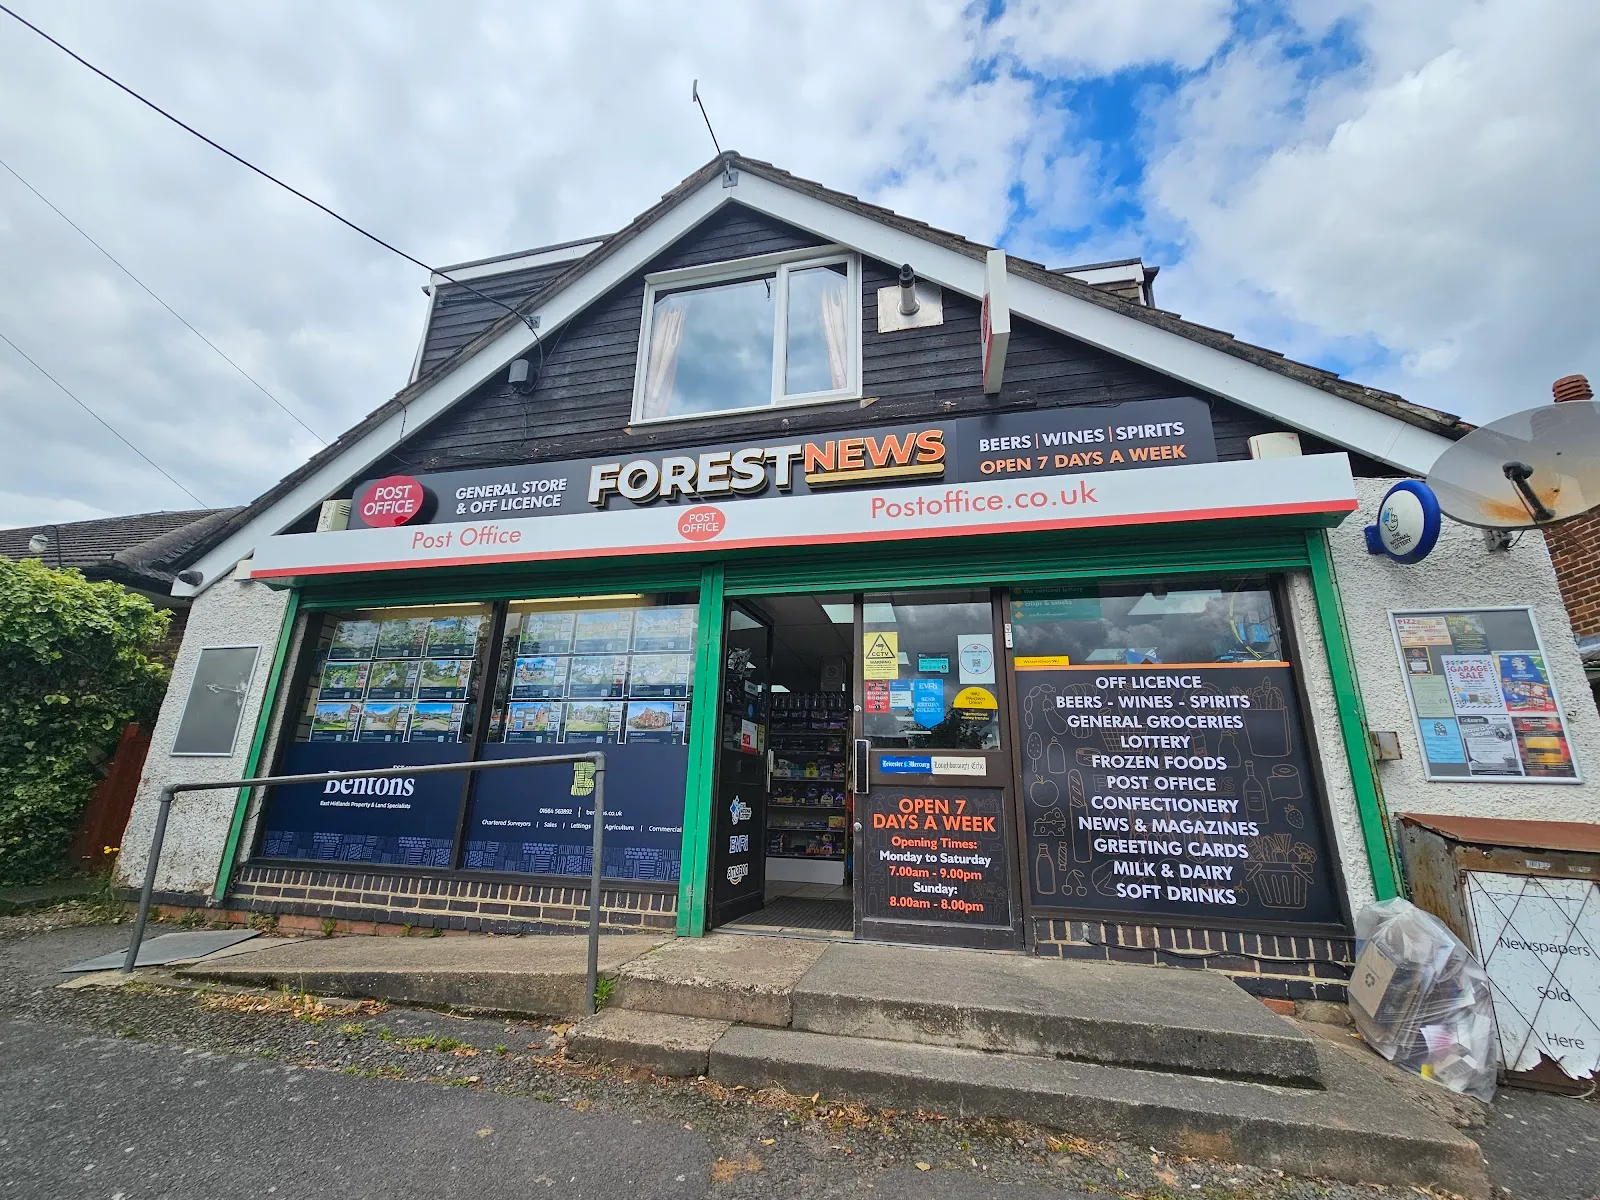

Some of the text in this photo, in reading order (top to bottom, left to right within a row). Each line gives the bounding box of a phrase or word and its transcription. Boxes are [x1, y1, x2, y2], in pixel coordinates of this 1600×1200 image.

[979, 421, 1185, 453] BEERS WINES SPIRITS
[587, 429, 946, 506] FOREST NEWS
[980, 444, 1187, 475] OPEN 7 DAYS A WEEK
[374, 485, 411, 501] POST
[455, 478, 568, 500] GENERAL STORE
[363, 499, 414, 516] OFFICE
[455, 495, 561, 515] & OFF LICENCE
[871, 480, 1099, 519] Postoffice.co.uk
[689, 512, 717, 523] POST
[681, 522, 720, 534] OFFICE
[412, 524, 521, 550] Post Office
[1450, 665, 1489, 673] GARAGE
[1095, 675, 1202, 690] OFF LICENCE
[1056, 695, 1102, 709] BEERS
[1118, 695, 1173, 709] WINES
[1190, 695, 1250, 709] SPIRITS
[1067, 715, 1243, 729] GENERAL GROCERIES
[1120, 735, 1191, 749] LOTTERY
[882, 759, 930, 769] Leicester Mercury
[971, 761, 985, 770] Echo
[1092, 755, 1228, 770] FROZEN FOODS
[322, 770, 416, 797] Bentons
[1107, 775, 1149, 790] POST
[1154, 777, 1217, 791] OFFICE
[898, 798, 967, 815] OPEN 7
[1091, 796, 1239, 814] CONFECTIONERY
[507, 820, 531, 828] Surveyors
[604, 823, 635, 831] Agriculture
[648, 825, 683, 833] Commercial
[873, 814, 996, 832] DAYS A WEEK
[1078, 816, 1260, 837] NEWS & MAGAZINES
[891, 836, 978, 850] Opening Times:
[1094, 838, 1249, 859] GREETING CARDS
[879, 850, 991, 868] Monday to Saturday
[889, 866, 929, 878] 7.00am
[939, 868, 982, 882] 9.00pm
[1113, 860, 1233, 881] MILK & DAIRY
[913, 882, 958, 896] Sunday:
[1116, 883, 1237, 905] SOFT DRINKS
[889, 896, 930, 909] 8.00am
[941, 899, 984, 913] 8.00pm
[1499, 937, 1591, 956] Newspapers
[1537, 986, 1572, 1002] Sold
[1546, 1032, 1585, 1049] Here
